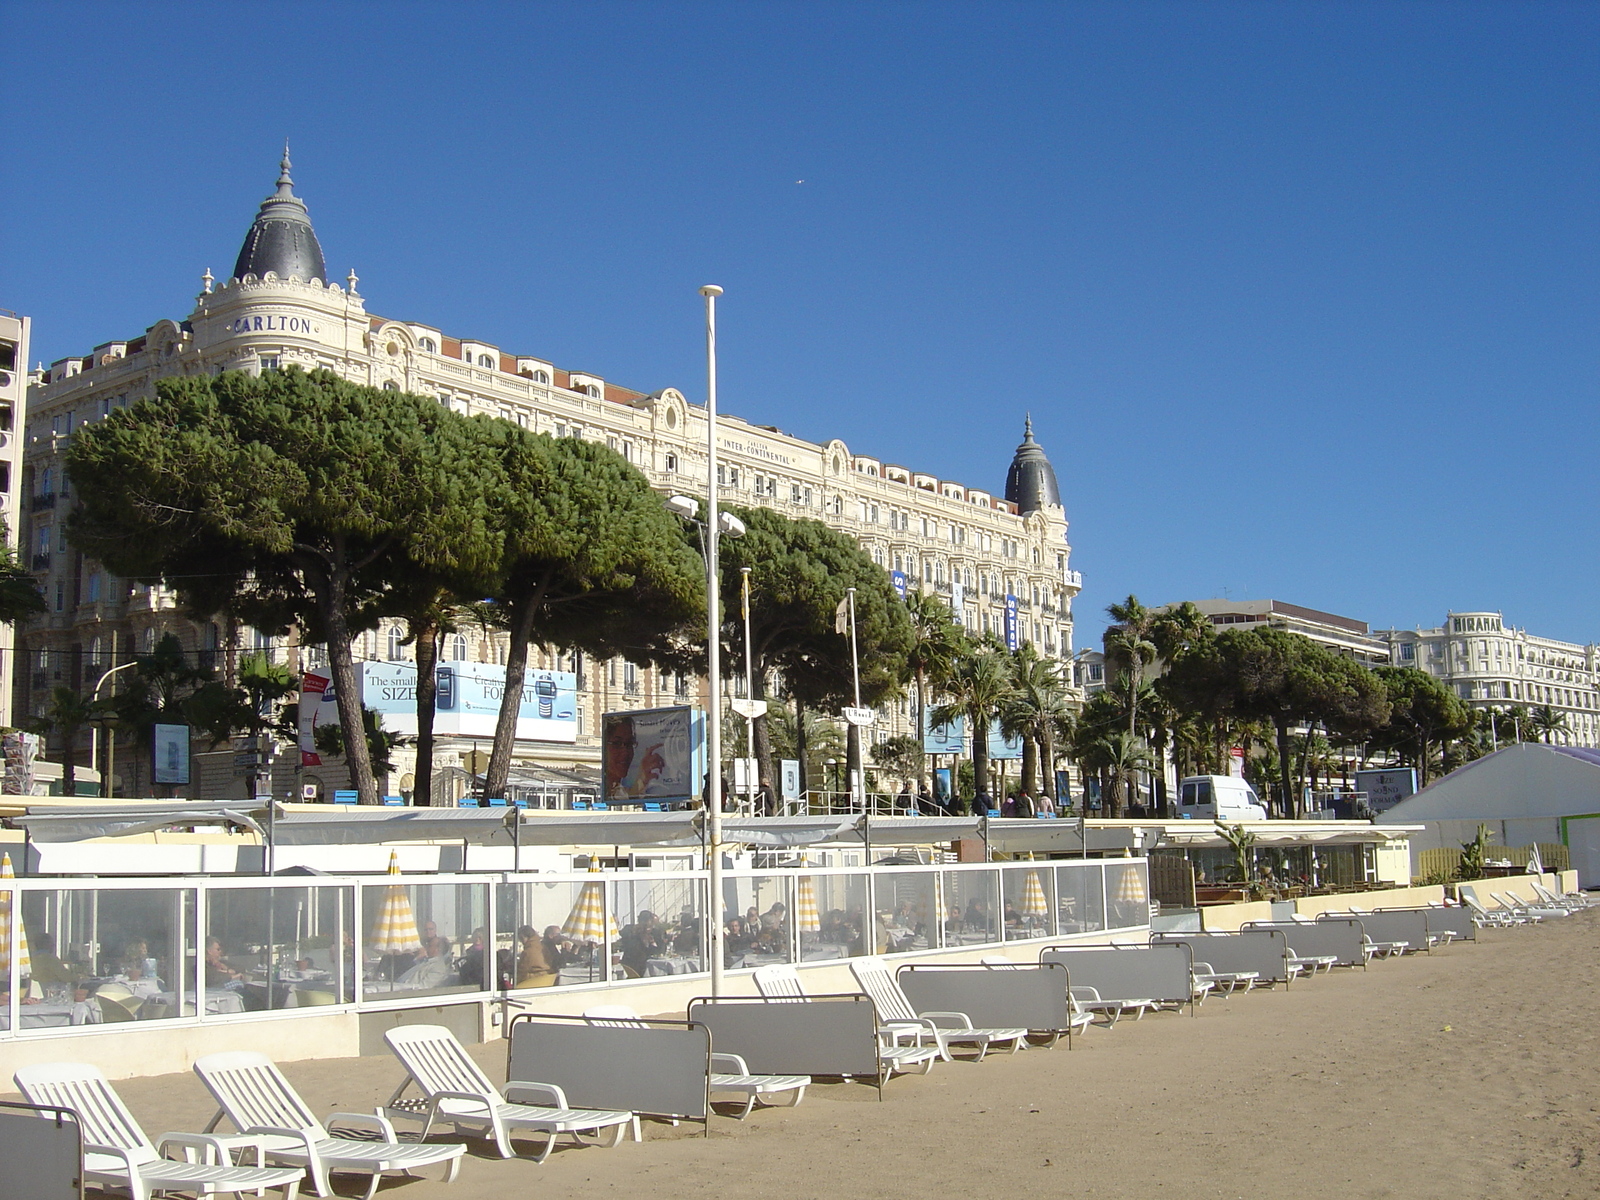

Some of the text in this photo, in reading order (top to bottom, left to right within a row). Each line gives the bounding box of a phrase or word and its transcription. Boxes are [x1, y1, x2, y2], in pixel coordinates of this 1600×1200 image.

[234, 315, 311, 334] CARLTON
[369, 676, 388, 686] The
[382, 687, 418, 700] SIZE
